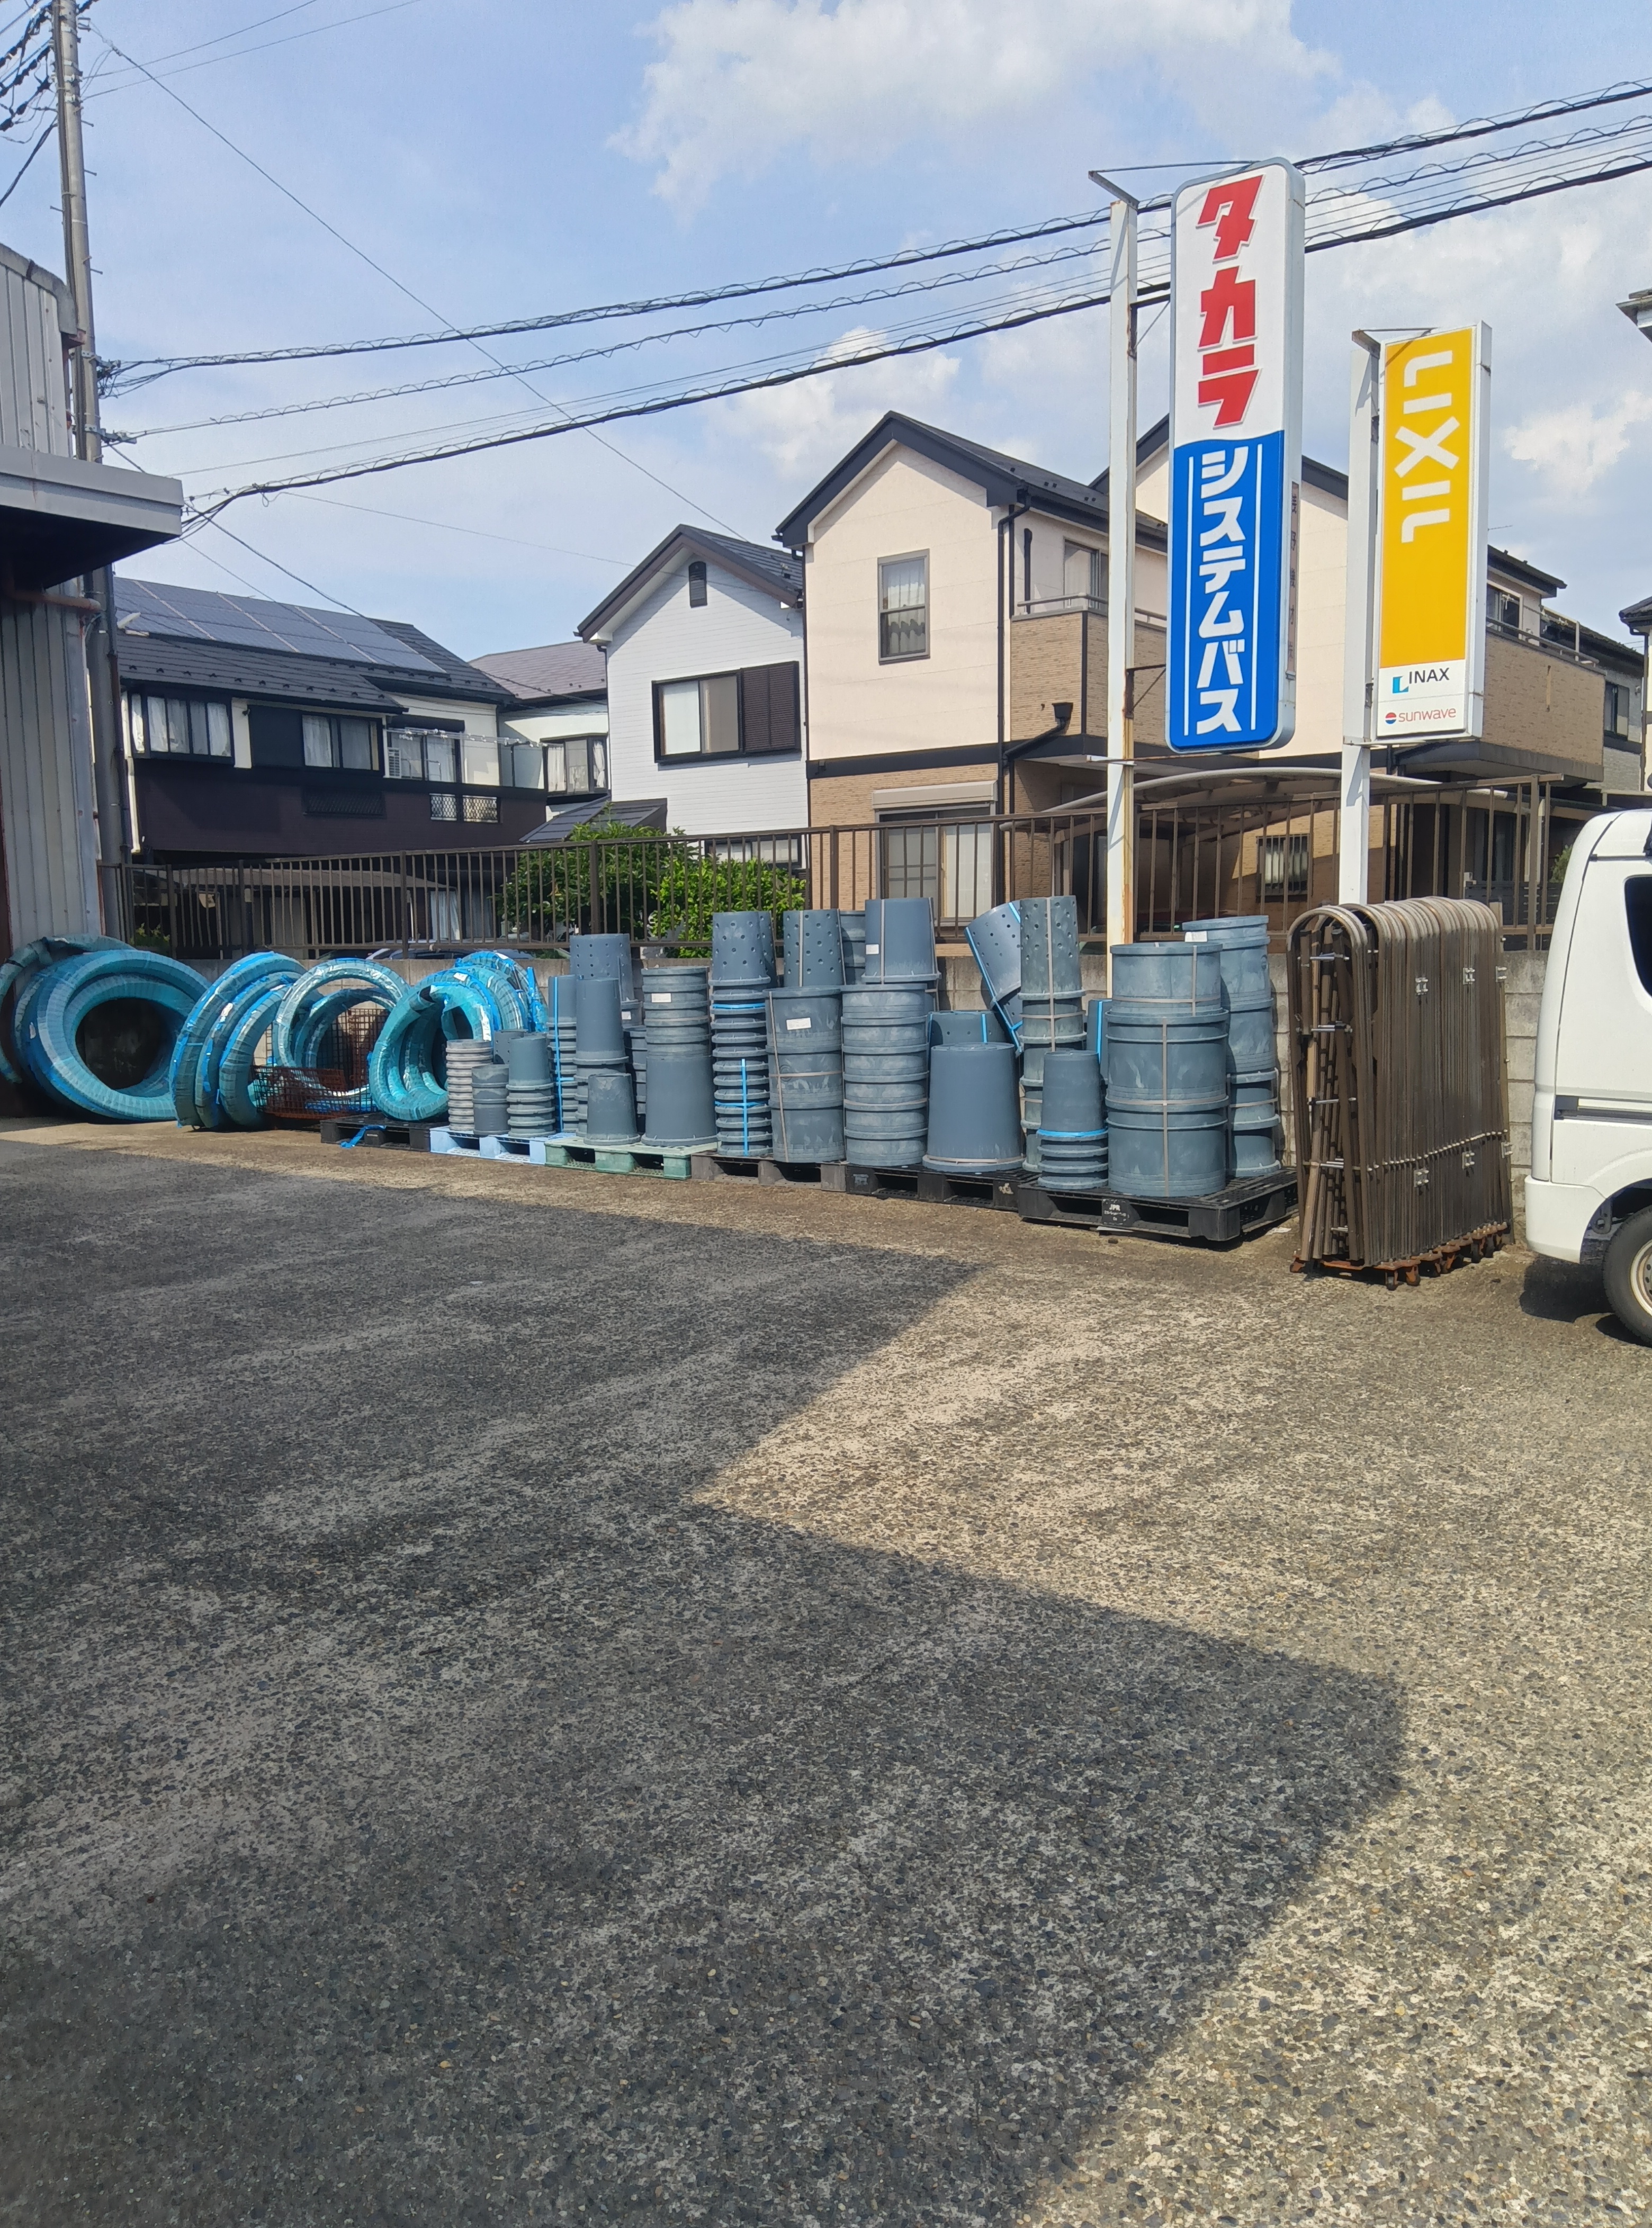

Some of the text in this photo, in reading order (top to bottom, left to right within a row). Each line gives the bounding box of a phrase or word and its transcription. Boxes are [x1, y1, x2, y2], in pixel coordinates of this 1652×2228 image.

[1198, 175, 1262, 427] タカラ
[1395, 351, 1460, 543] LIXIL
[1197, 446, 1249, 735] システムバス
[1408, 668, 1450, 684] INAX
[1398, 708, 1456, 722] sunwave
